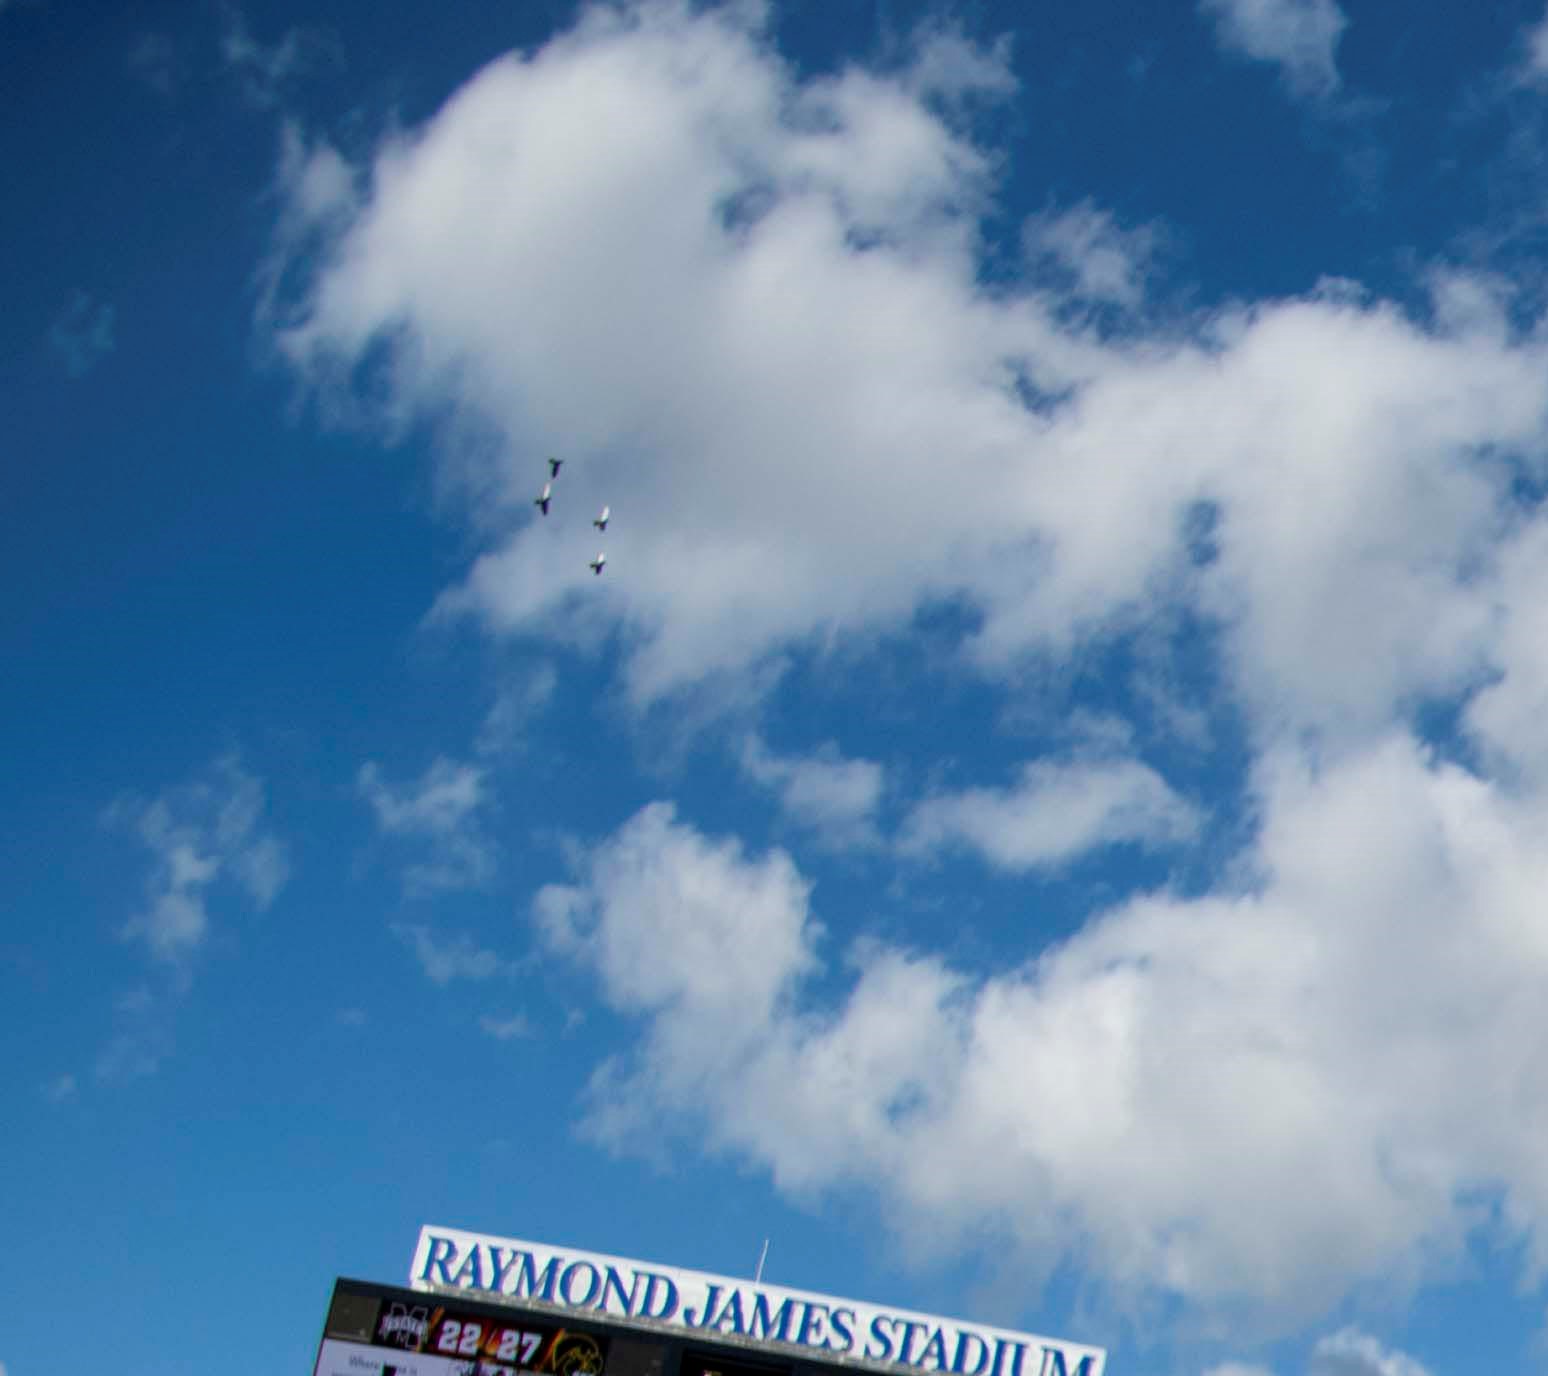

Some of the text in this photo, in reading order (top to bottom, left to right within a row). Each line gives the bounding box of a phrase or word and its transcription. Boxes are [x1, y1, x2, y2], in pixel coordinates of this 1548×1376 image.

[420, 1234, 679, 1321] RAYMOND
[683, 1282, 857, 1354] JAMES
[436, 1318, 484, 1355] 22
[495, 1328, 543, 1365] 27
